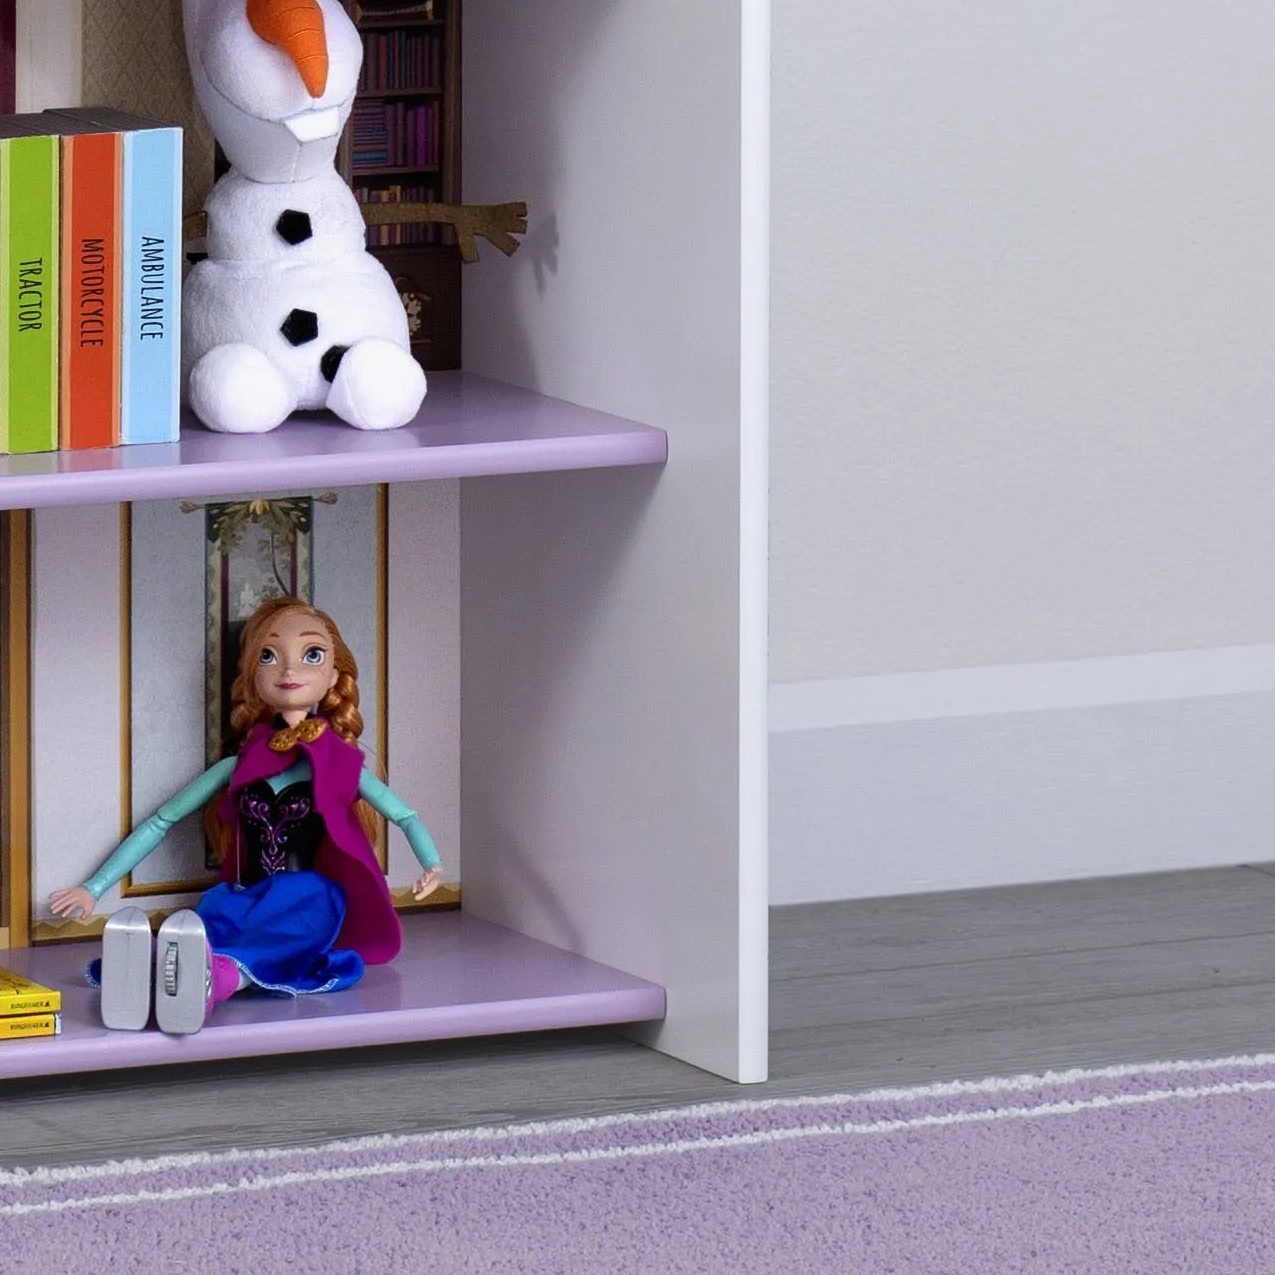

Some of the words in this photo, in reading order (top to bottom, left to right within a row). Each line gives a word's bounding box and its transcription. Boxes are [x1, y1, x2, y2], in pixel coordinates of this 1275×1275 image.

[18, 257, 42, 332] TRACTOR
[80, 238, 105, 348] MOTORCYCLE
[140, 236, 164, 340] AMBULANCE
